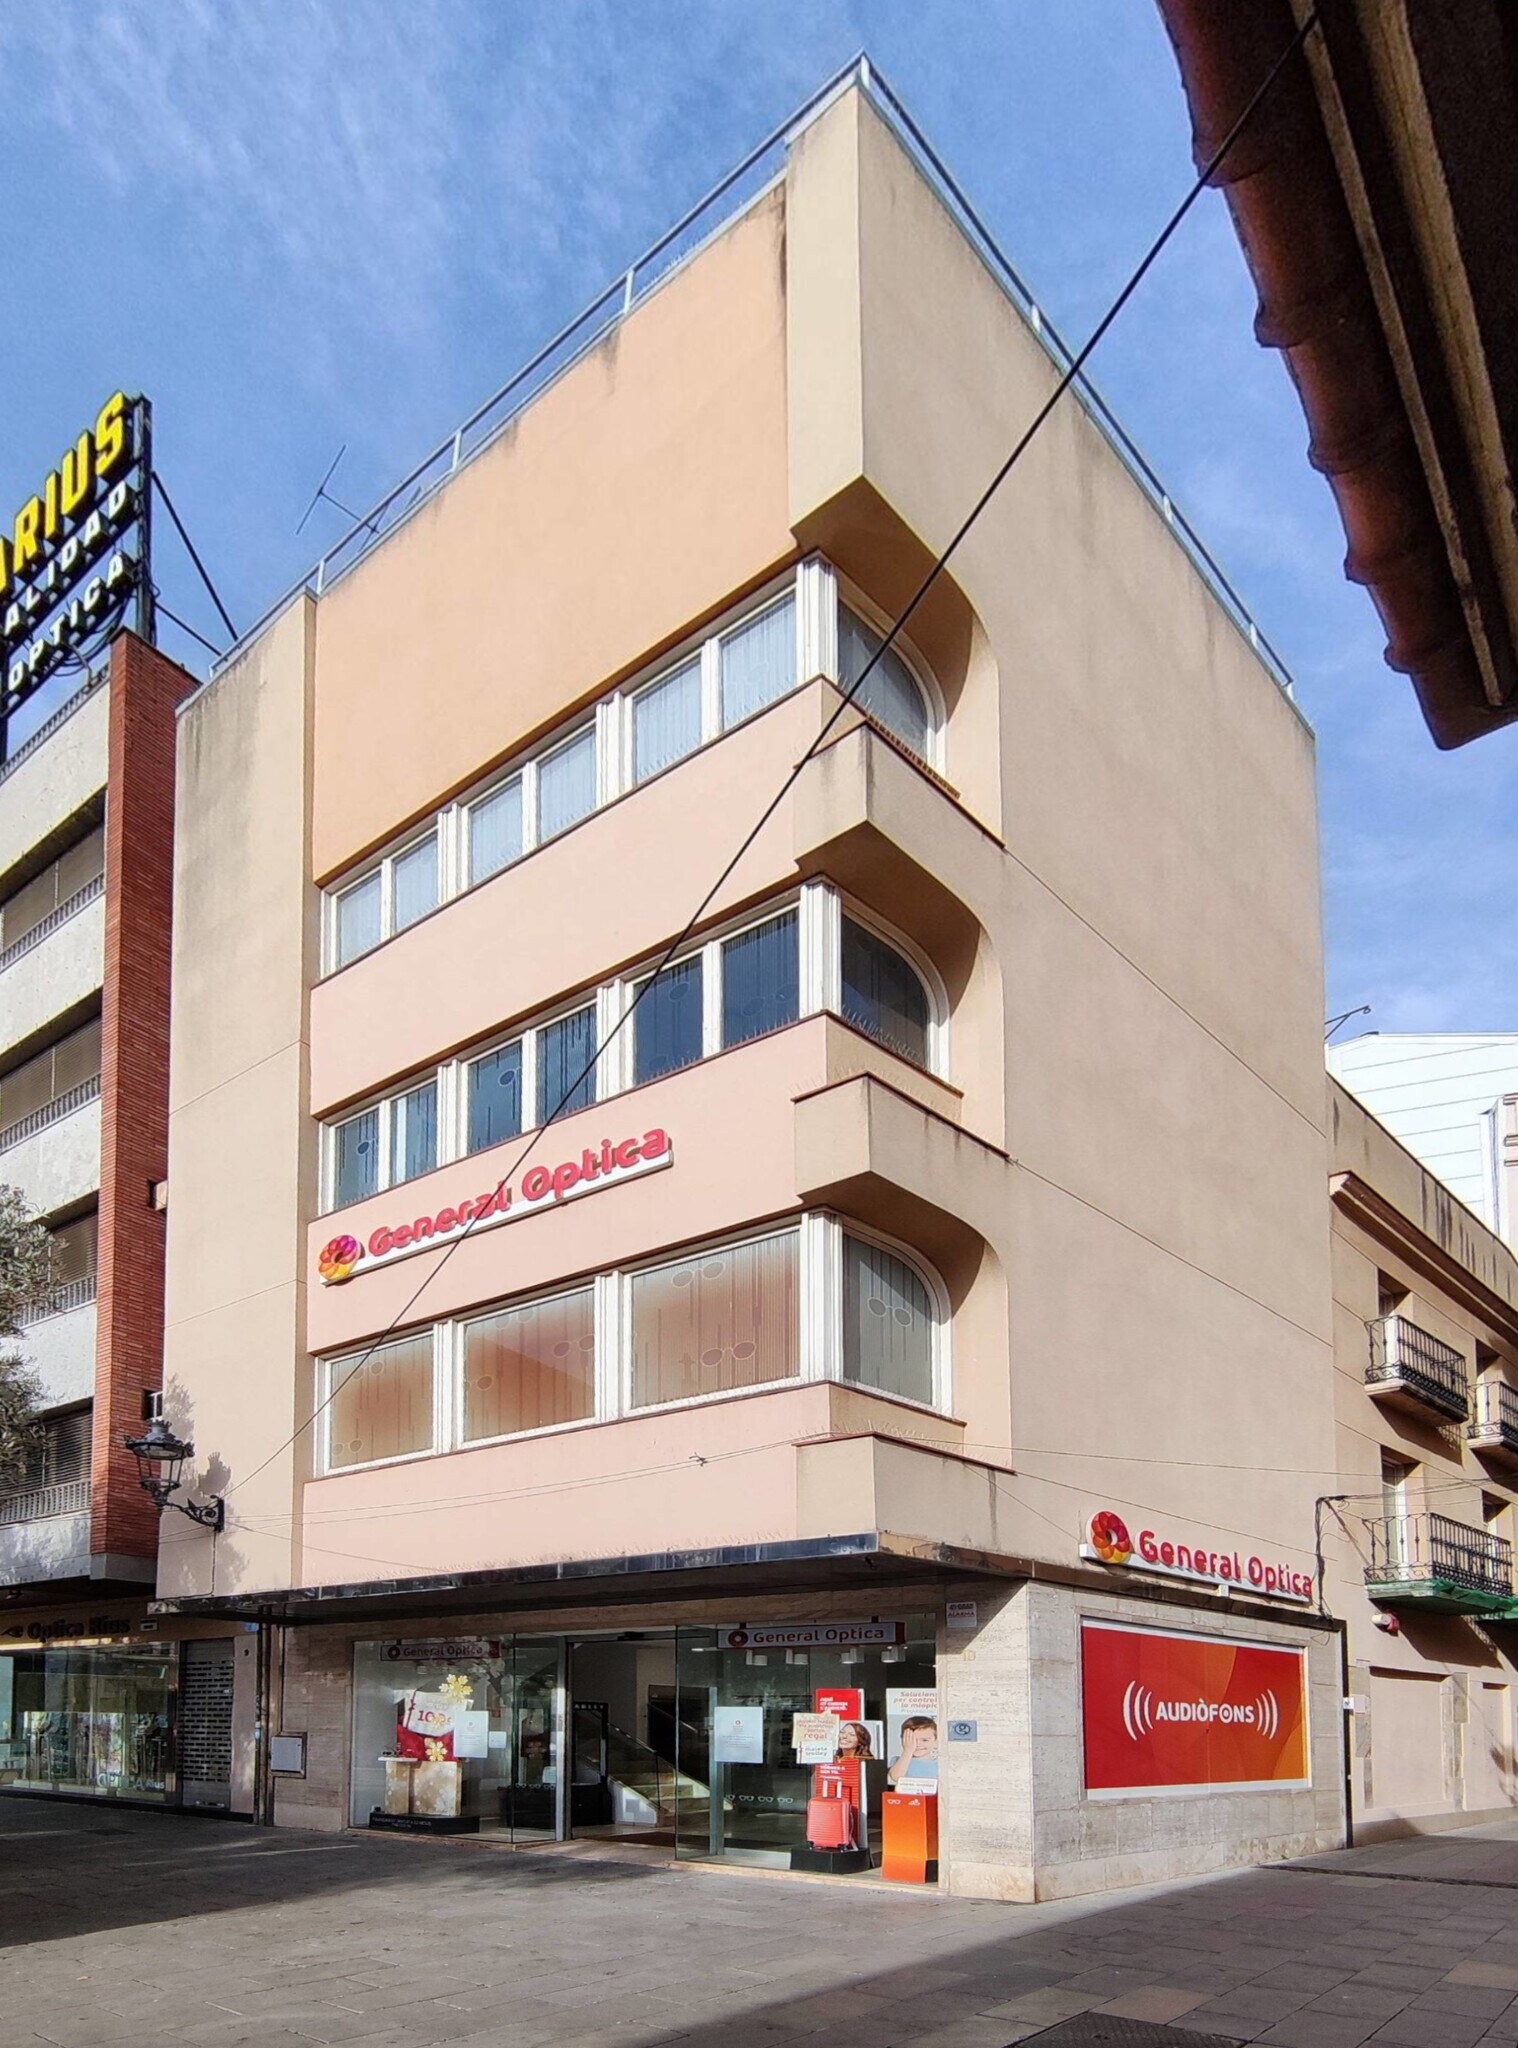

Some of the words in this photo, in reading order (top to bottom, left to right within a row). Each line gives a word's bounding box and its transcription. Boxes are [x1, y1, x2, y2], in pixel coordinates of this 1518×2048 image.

[0, 391, 125, 592] RIUS
[8, 551, 124, 692] OPTICA
[368, 1180, 510, 1257] General
[521, 1128, 668, 1200] Optica
[1138, 1531, 1241, 1581] General
[1248, 1556, 1312, 1596] Optica
[403, 1644, 444, 1657] General
[446, 1644, 483, 1658] Optica
[753, 1629, 820, 1644] General
[825, 1627, 885, 1643] Optica
[1156, 1698, 1255, 1724] AUDIÒFONS
